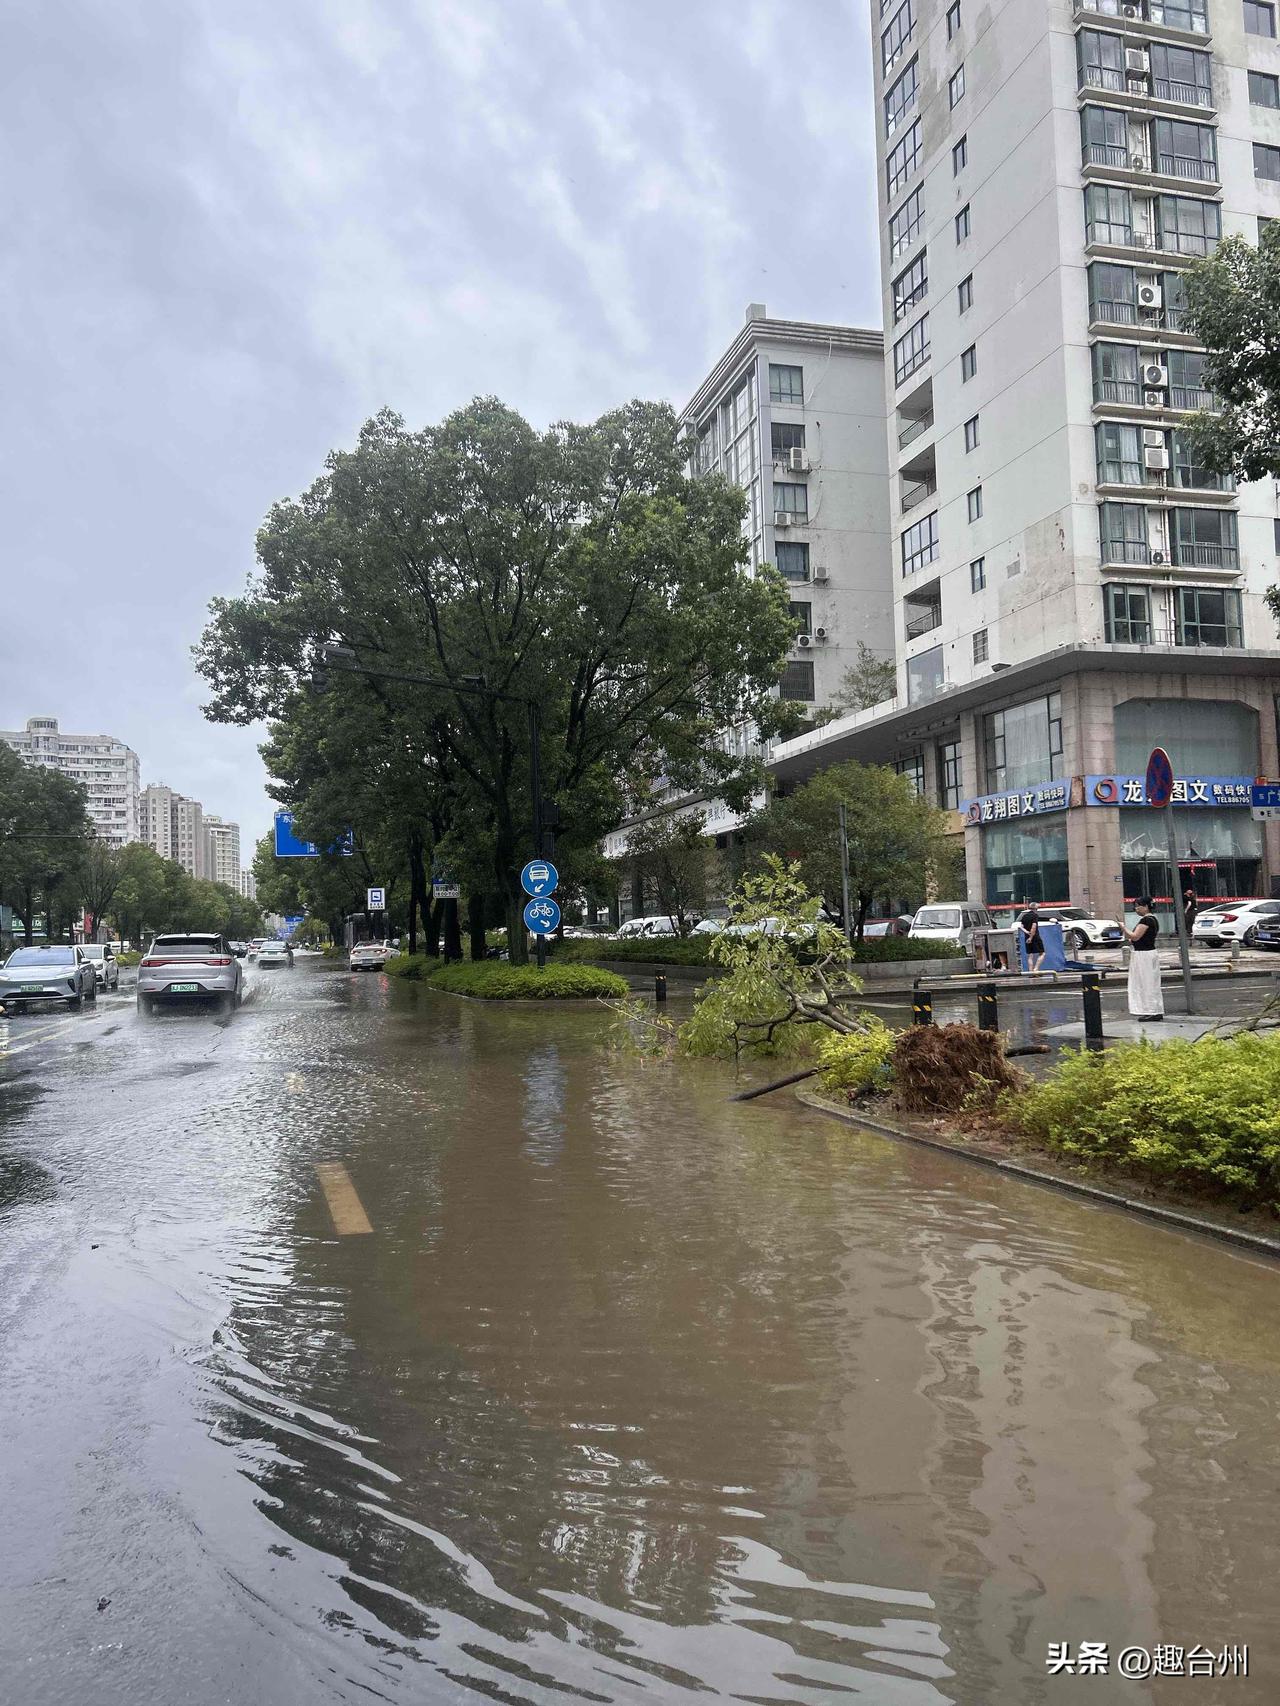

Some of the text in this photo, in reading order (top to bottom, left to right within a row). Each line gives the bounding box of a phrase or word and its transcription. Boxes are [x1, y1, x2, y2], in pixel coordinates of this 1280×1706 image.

[1123, 779, 1209, 802] 龙图文
[982, 792, 1035, 820] 龙翔图文
